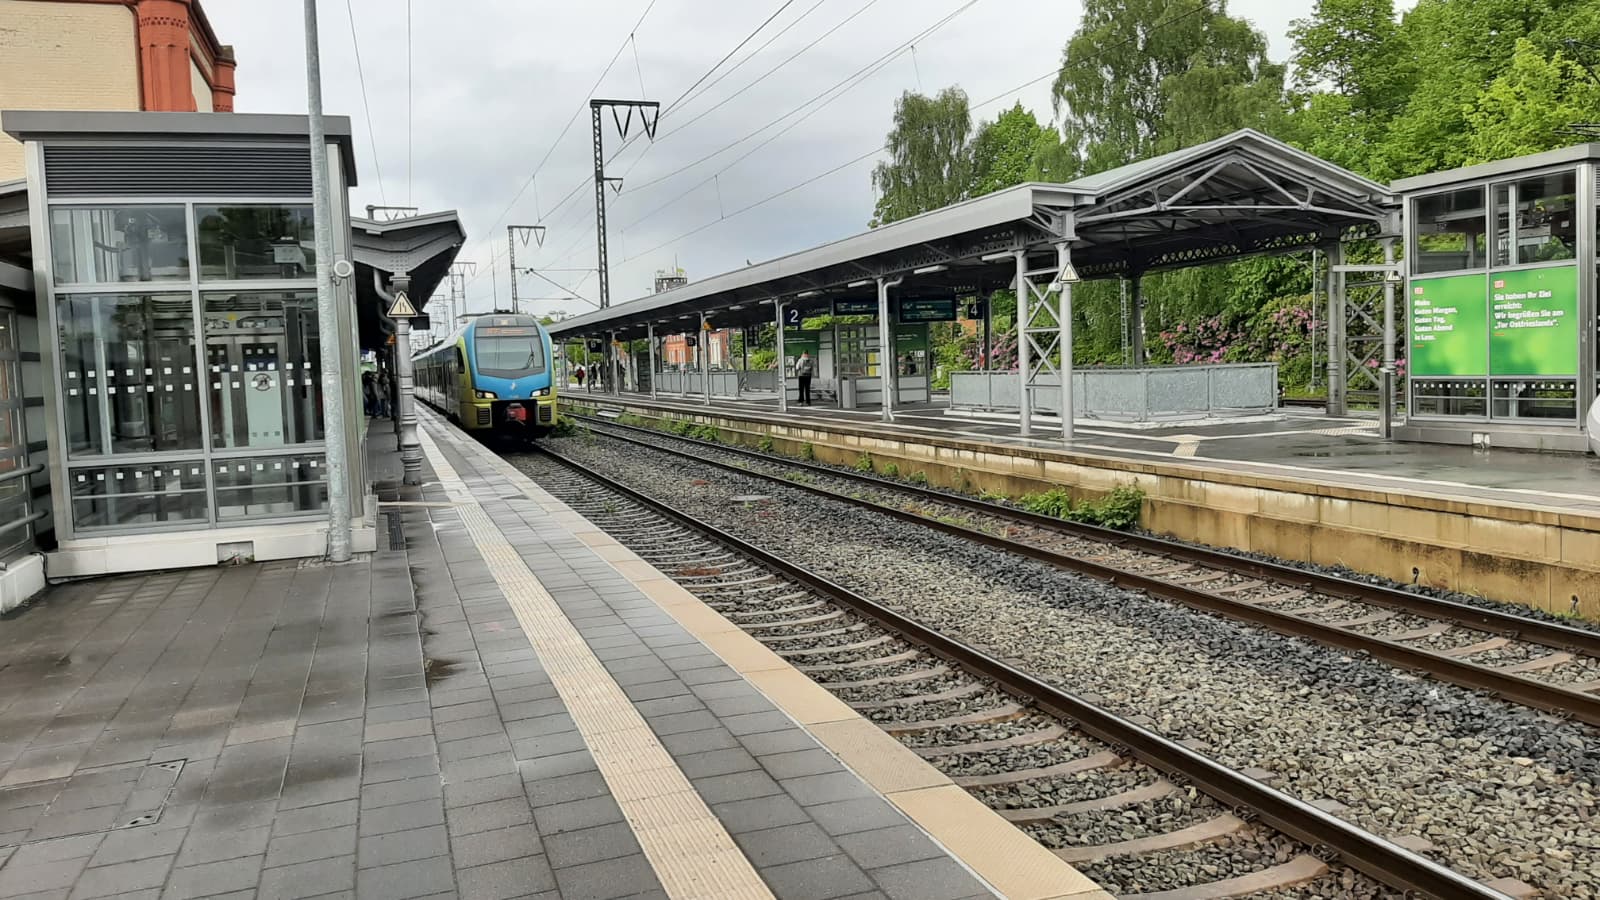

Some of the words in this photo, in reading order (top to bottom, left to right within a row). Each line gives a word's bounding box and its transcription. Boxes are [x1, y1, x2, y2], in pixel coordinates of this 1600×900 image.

[1494, 293, 1504, 301] Sie
[1538, 290, 1552, 298] Ziel
[790, 309, 798, 322] 2
[1508, 310, 1540, 320] begrüßen
